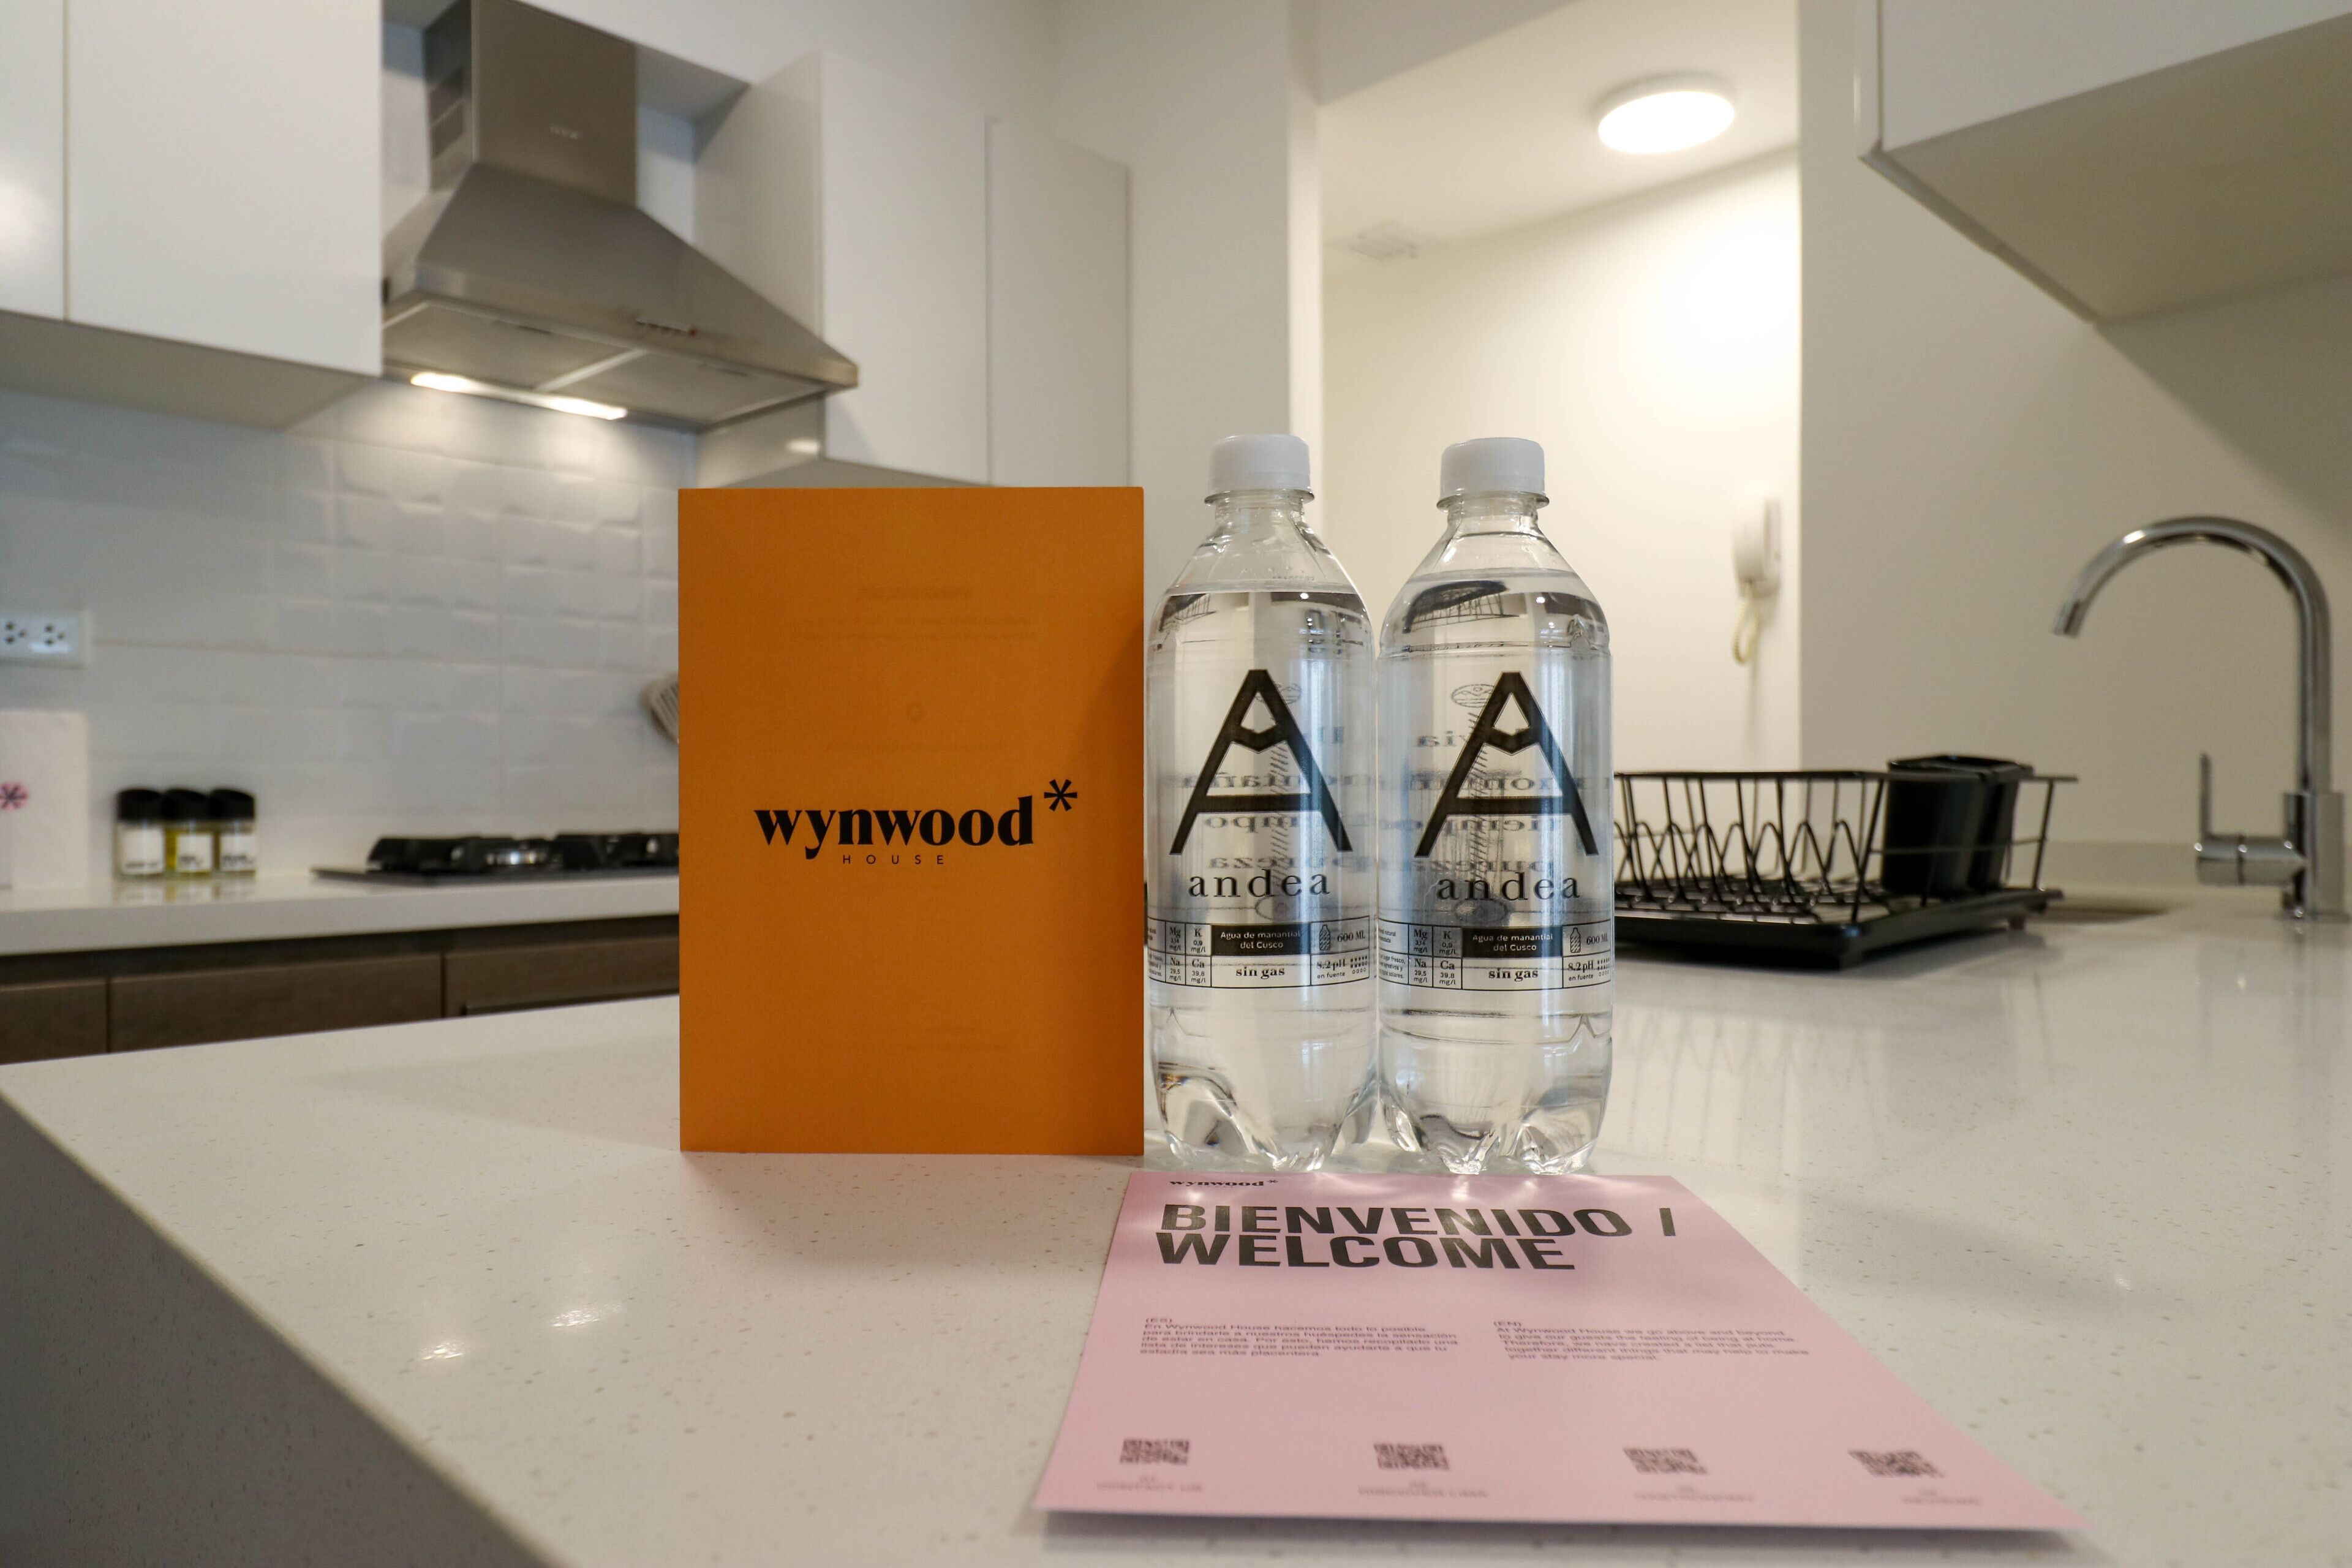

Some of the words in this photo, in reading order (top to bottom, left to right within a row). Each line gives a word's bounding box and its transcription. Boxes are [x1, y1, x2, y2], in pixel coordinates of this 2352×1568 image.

[1169, 669, 1353, 856] A
[1414, 671, 1599, 857] A
[843, 855, 944, 865] HOUSE
[1187, 869, 1330, 897] andea
[1436, 872, 1581, 901] andea
[1169, 926, 1181, 938] Mg
[1194, 928, 1202, 937] K
[1220, 931, 1242, 940] Agua
[1257, 930, 1301, 938] manantial
[1337, 932, 1354, 942] 600
[1355, 930, 1365, 940] ML
[1414, 929, 1428, 941] Mg
[1443, 930, 1451, 940] K
[1472, 934, 1494, 943] Agua
[1510, 933, 1553, 941] manantial
[1586, 935, 1600, 945] 600
[1170, 957, 1180, 966] Na
[1191, 959, 1205, 968] Ca
[1414, 958, 1427, 968] Na
[1439, 960, 1455, 970] Ca
[1235, 966, 1257, 977] sin
[1260, 967, 1286, 980] gas
[1488, 967, 1511, 979] sin
[1514, 969, 1539, 982] gas
[1160, 1204, 1633, 1238] BIENVENIDO
[1156, 1232, 1576, 1270] WELCOME
